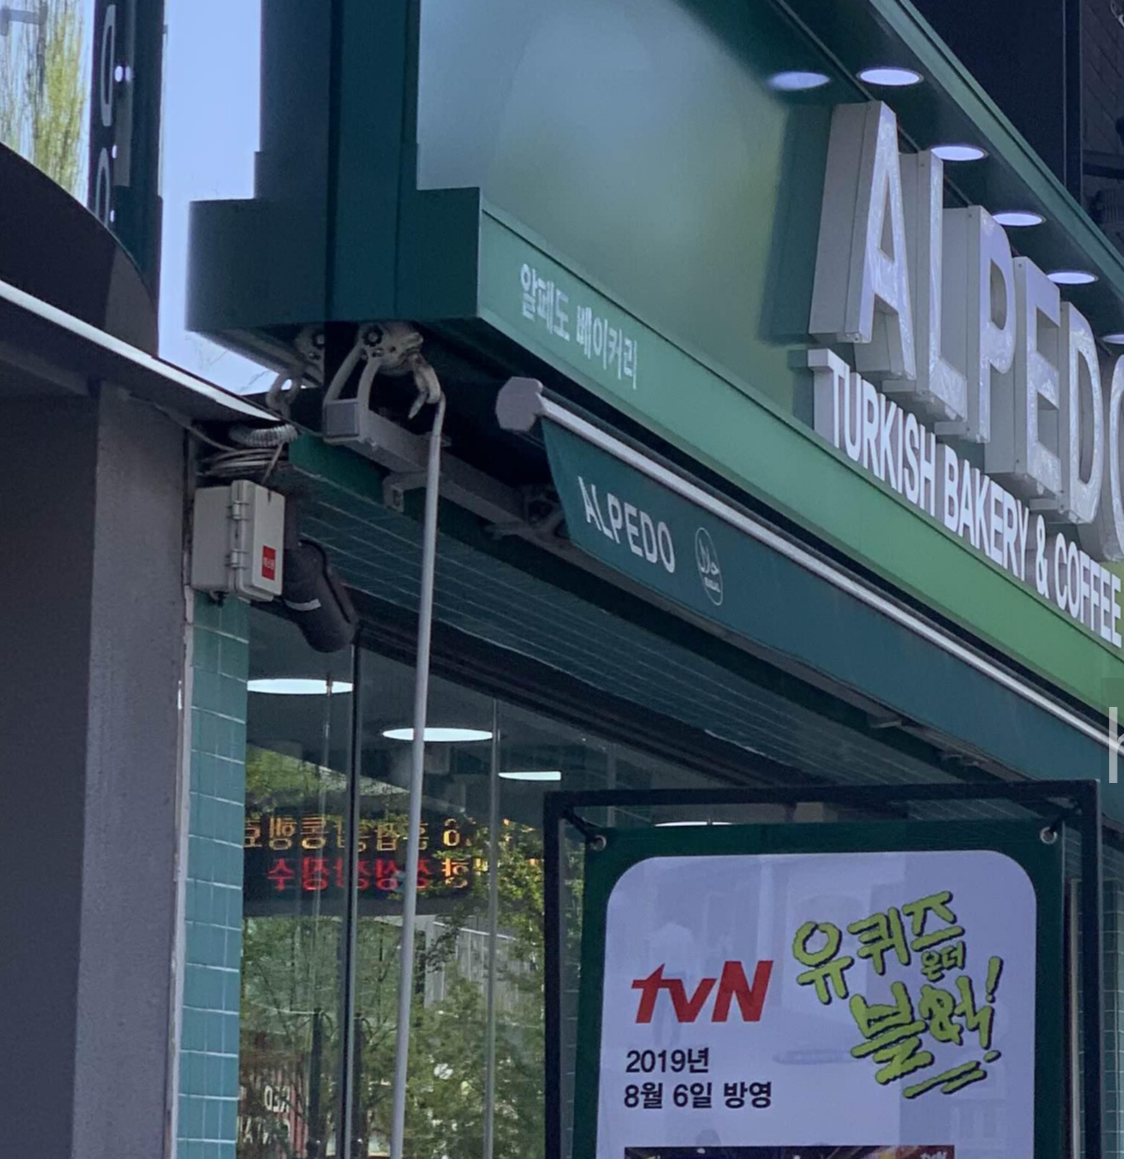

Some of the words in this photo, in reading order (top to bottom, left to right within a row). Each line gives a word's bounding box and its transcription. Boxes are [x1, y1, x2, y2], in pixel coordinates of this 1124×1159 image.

[520, 262, 570, 342] 알페도
[576, 305, 638, 390] 베이커리
[578, 476, 676, 573] ALPEDO
[822, 348, 937, 517] TURKISH
[941, 443, 1030, 580] BAKERY
[1035, 513, 1049, 598] &
[1053, 531, 1123, 648] COFFEE
[631, 960, 774, 1024] tvN
[623, 1082, 664, 1109] 8월
[673, 1082, 713, 1109] 6일
[723, 1082, 773, 1110] 방영
[626, 1047, 711, 1074] 2019년
